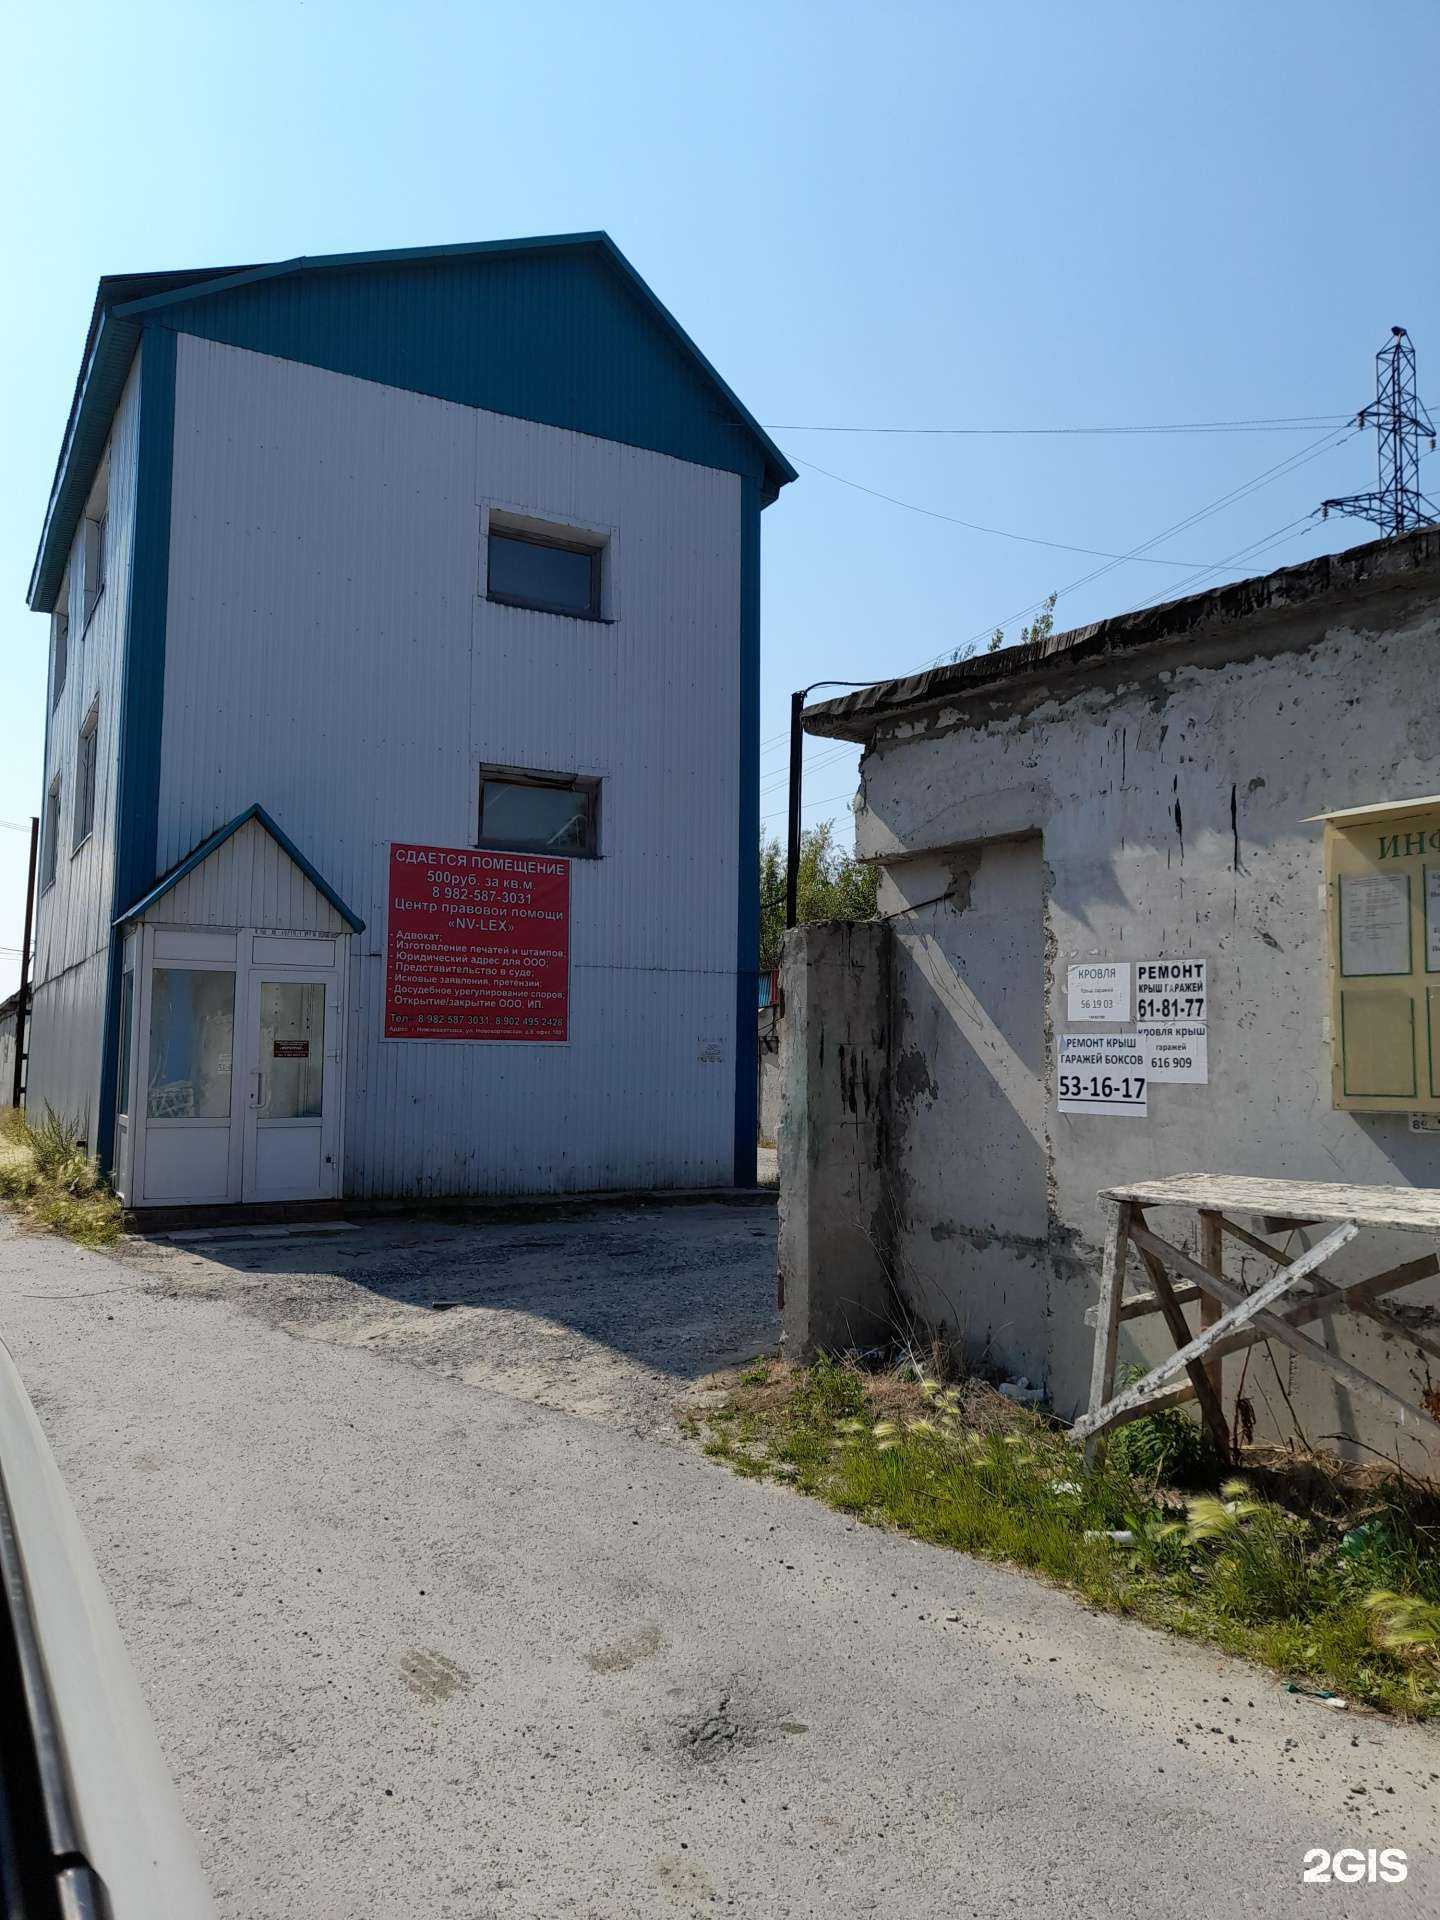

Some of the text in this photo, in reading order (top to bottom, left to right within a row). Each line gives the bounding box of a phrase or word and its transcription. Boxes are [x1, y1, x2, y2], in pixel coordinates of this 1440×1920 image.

[395, 849, 565, 876] СДАЕТСЯ ПОМЕЩЕНИЕ
[427, 870, 480, 887] 500руб.
[485, 878, 499, 888] за
[432, 887, 532, 905] 8 982-587-3031
[395, 898, 437, 913] Центр
[511, 909, 563, 921] помощи
[448, 918, 514, 933] «NV-LEX»
[396, 940, 468, 953] Изготовление
[395, 961, 498, 975] Представительство
[470, 956, 500, 966] адрес
[502, 958, 521, 967] для
[1078, 968, 1116, 980] КРОВЛЯ
[1138, 964, 1204, 980] РЕМОНТ
[394, 984, 452, 995] Досудебное
[1138, 984, 1162, 994] КРЫШ
[1081, 999, 1113, 1009] 56 19 03
[1138, 998, 1204, 1018] 61-81-77
[1175, 1027, 1206, 1038] крыш
[1066, 1038, 1137, 1049] РЕМОНТ КРЫШ
[1155, 1043, 1187, 1052] гаражей
[1060, 1053, 1144, 1066] ГАРАЖЕЙ БОКСОВ
[1151, 1057, 1192, 1069] 616 909
[1059, 1075, 1146, 1099] 53-16-17
